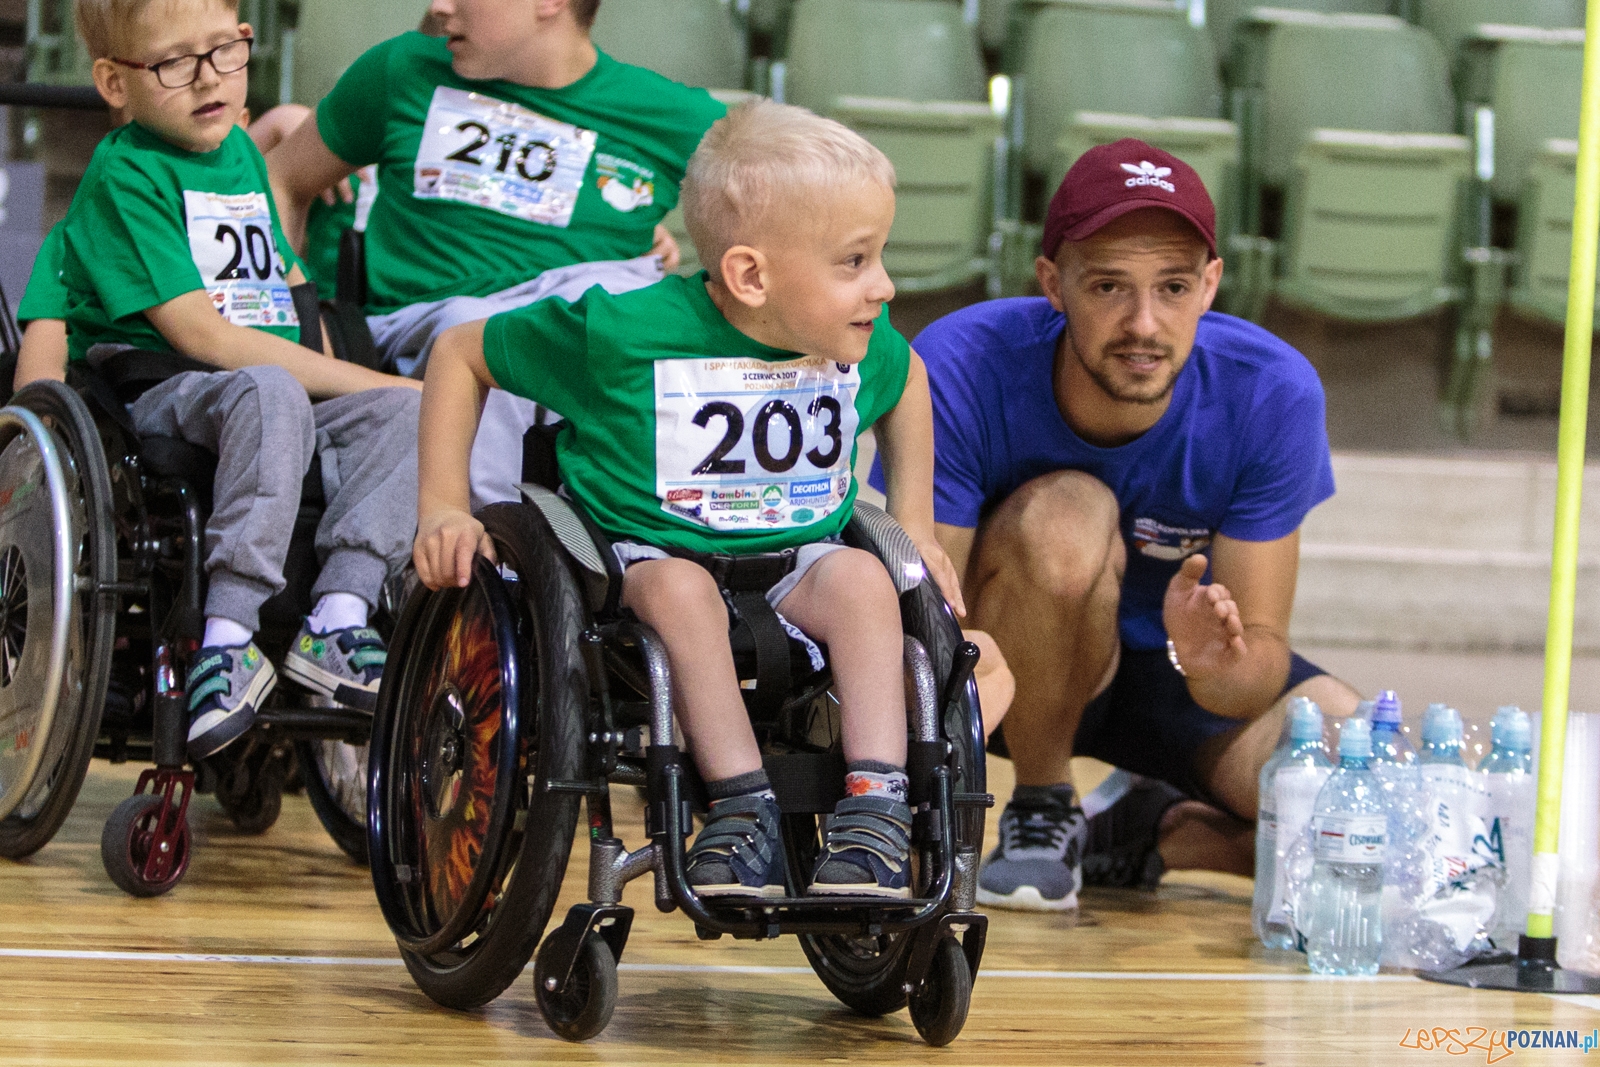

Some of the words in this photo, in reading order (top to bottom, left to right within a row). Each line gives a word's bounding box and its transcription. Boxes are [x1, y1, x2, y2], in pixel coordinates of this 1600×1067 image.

[446, 121, 557, 181] 210
[1125, 174, 1175, 193] adidas
[749, 372, 781, 380] CZERWCA
[782, 371, 797, 379] 2017
[691, 395, 842, 476] 203
[711, 489, 757, 499] bambino
[792, 482, 829, 494] DECATHLON
